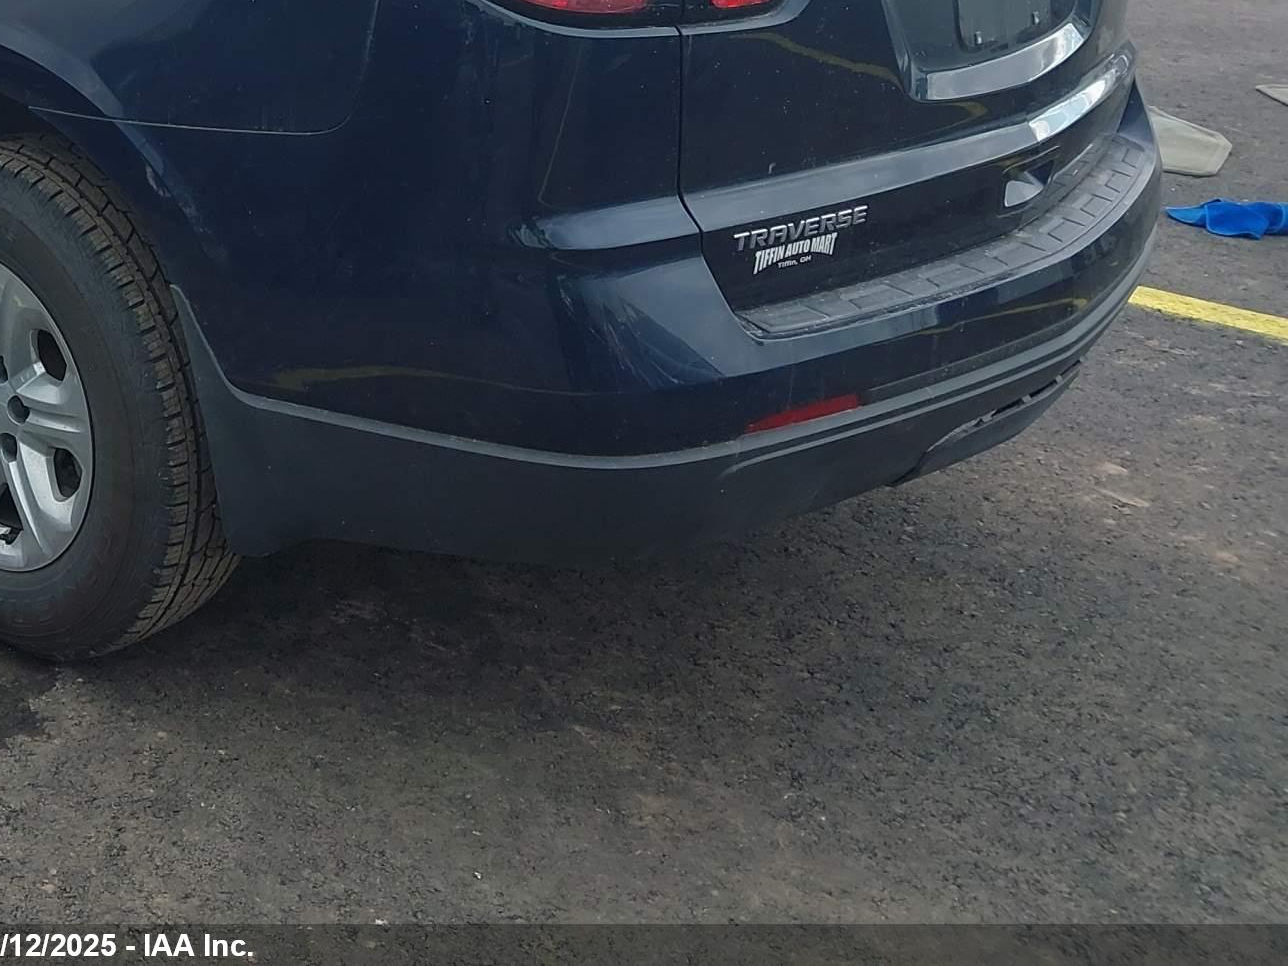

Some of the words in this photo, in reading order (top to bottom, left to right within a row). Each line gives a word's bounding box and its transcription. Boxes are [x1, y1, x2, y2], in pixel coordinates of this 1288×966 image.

[733, 204, 868, 251] TRAVERSE
[753, 244, 785, 275] TIFFIN
[785, 239, 811, 258] AUTO
[810, 232, 838, 256] MART
[799, 255, 812, 264] OH
